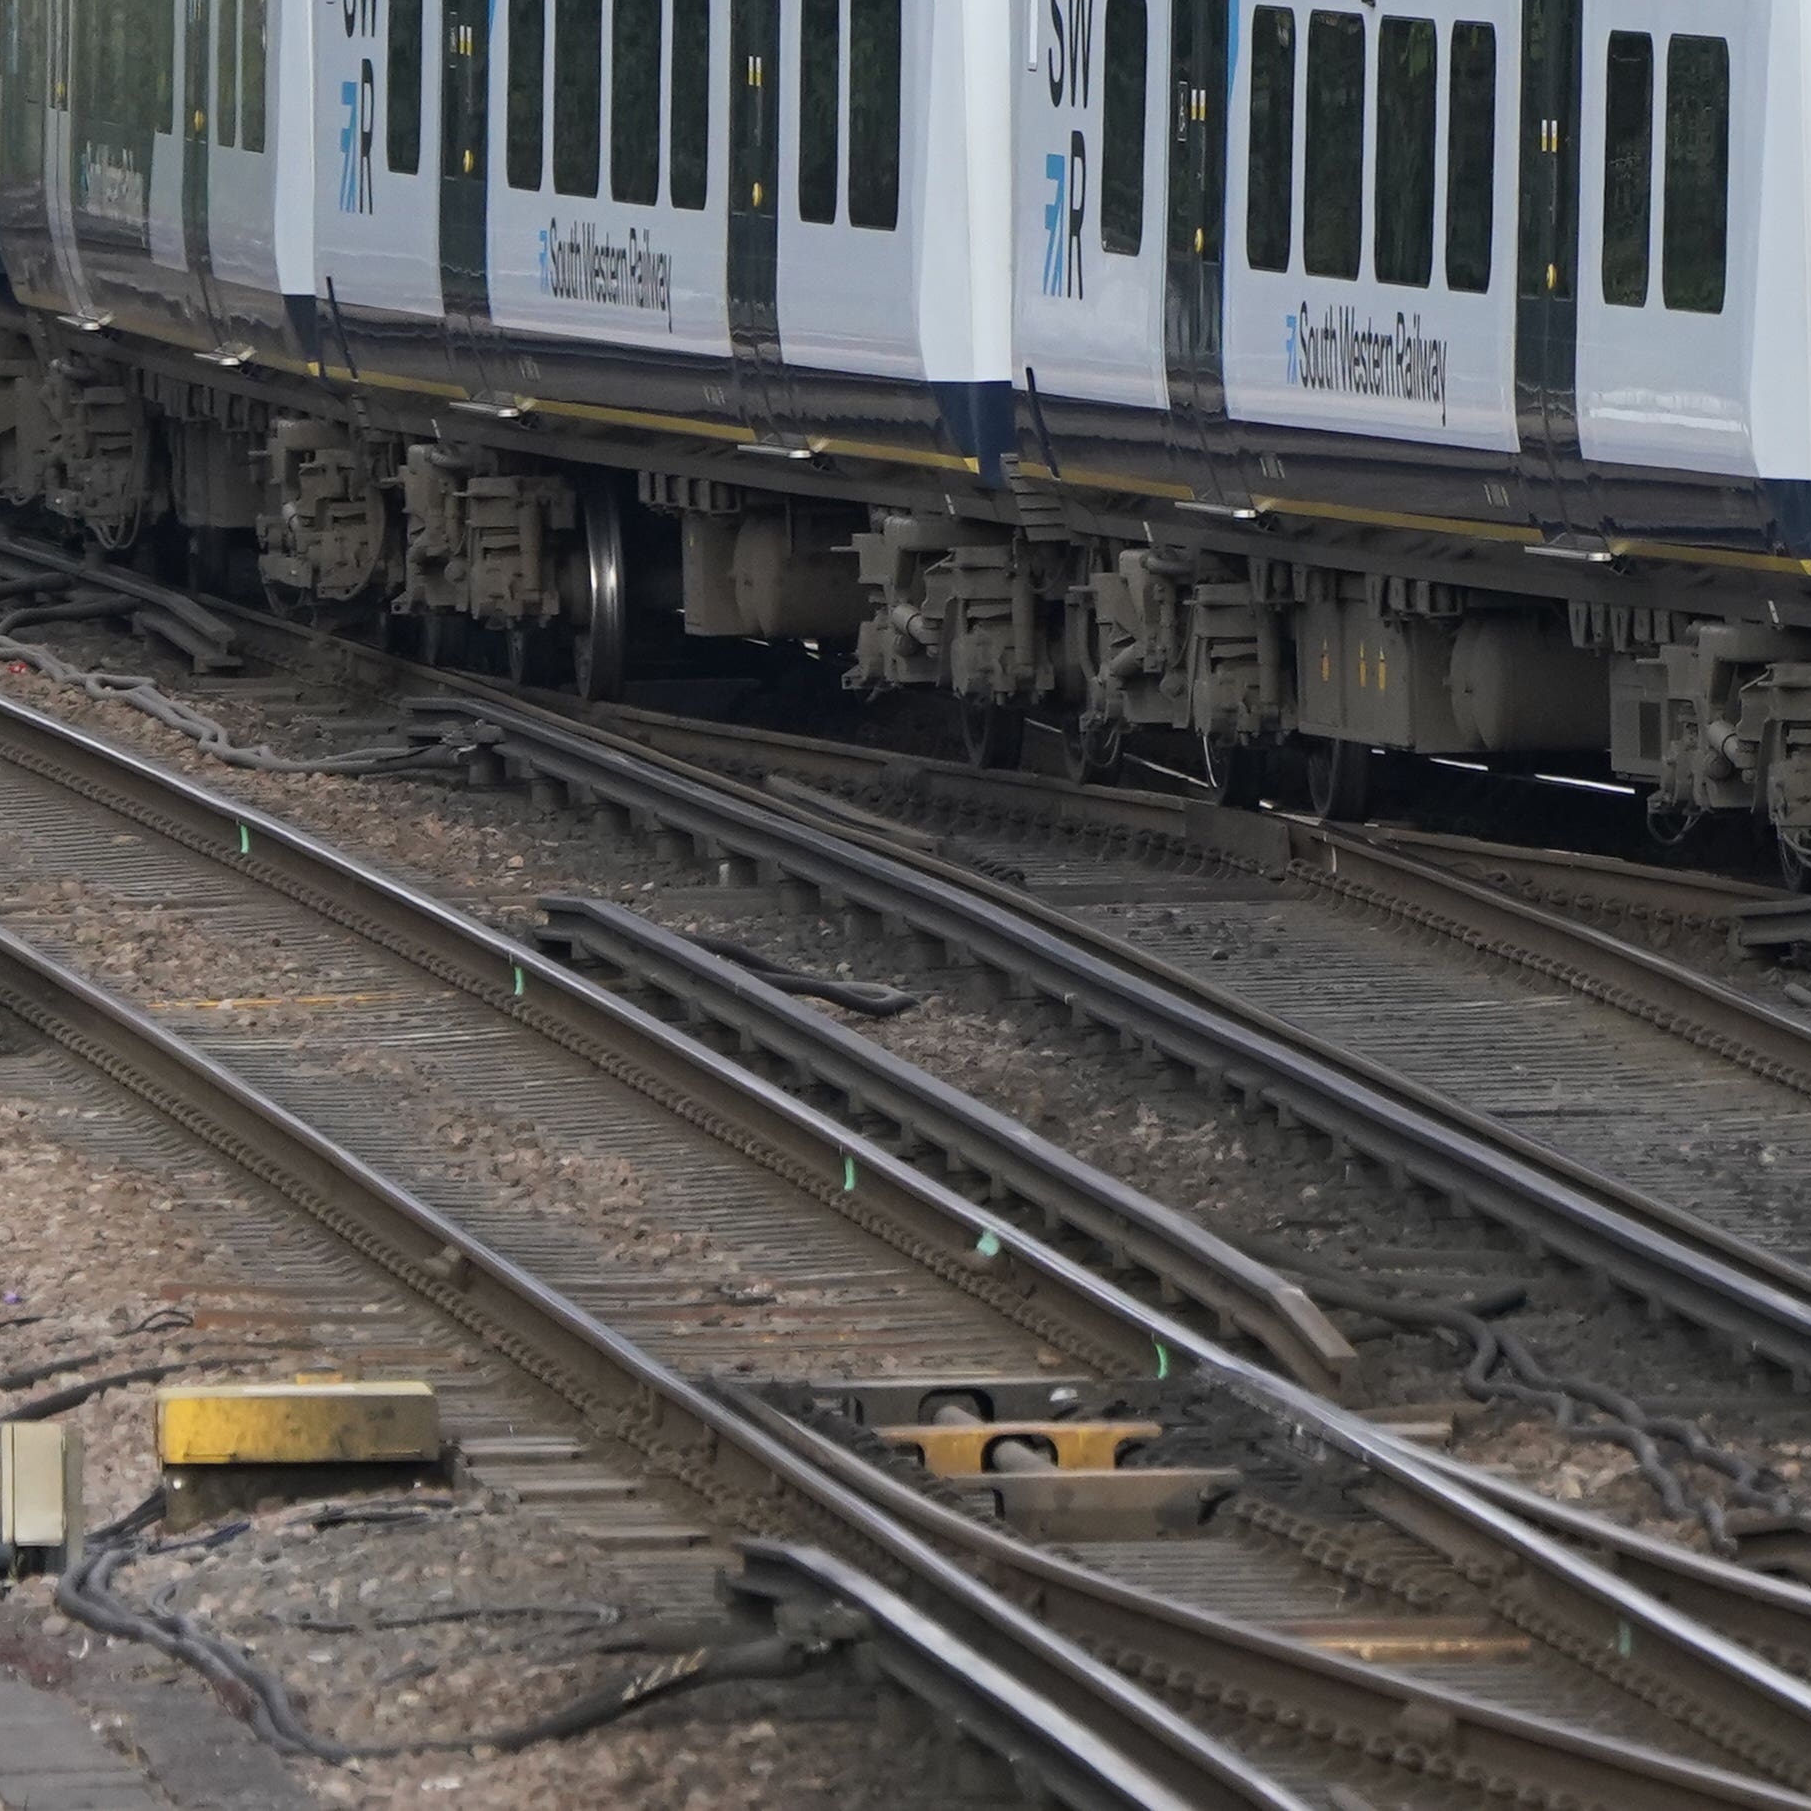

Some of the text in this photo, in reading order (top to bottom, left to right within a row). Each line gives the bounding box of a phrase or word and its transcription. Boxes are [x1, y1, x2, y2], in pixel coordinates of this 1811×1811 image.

[359, 58, 374, 215] R
[550, 217, 583, 300] South
[582, 222, 629, 306] Western
[1067, 130, 1086, 300] R
[1299, 300, 1447, 427] South Western Railway
